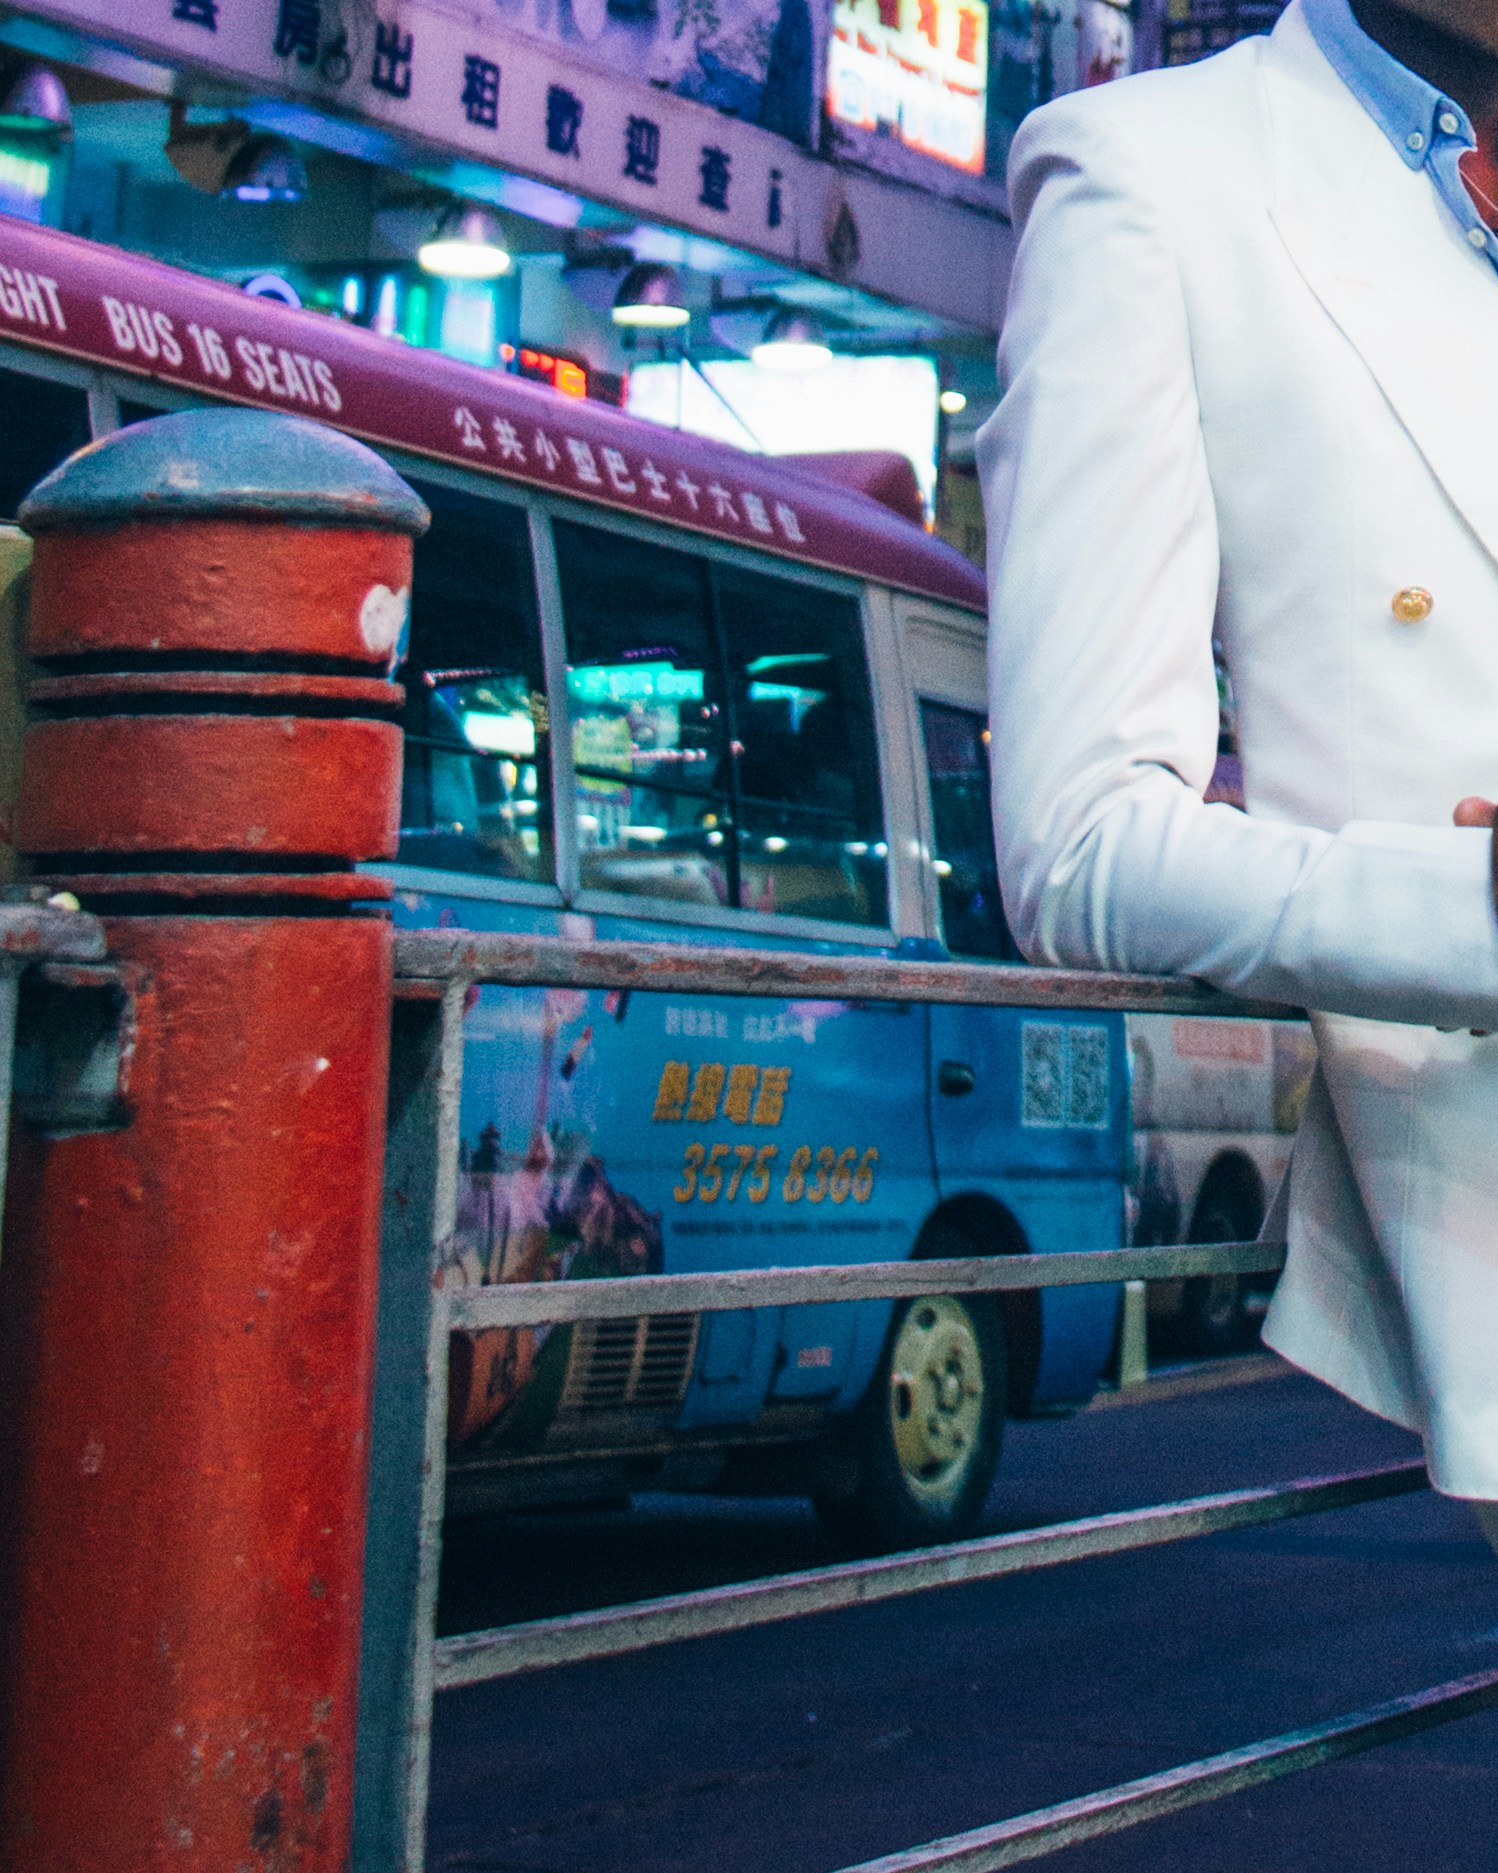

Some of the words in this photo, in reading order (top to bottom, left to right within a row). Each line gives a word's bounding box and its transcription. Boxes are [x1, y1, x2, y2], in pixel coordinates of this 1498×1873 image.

[102, 295, 184, 367] BUS
[187, 322, 232, 381] 16
[236, 336, 344, 413] SEATS
[453, 406, 806, 544] 公共小型巴士十六座位
[673, 1142, 778, 1204] 3575
[783, 1144, 879, 1204] 8366
